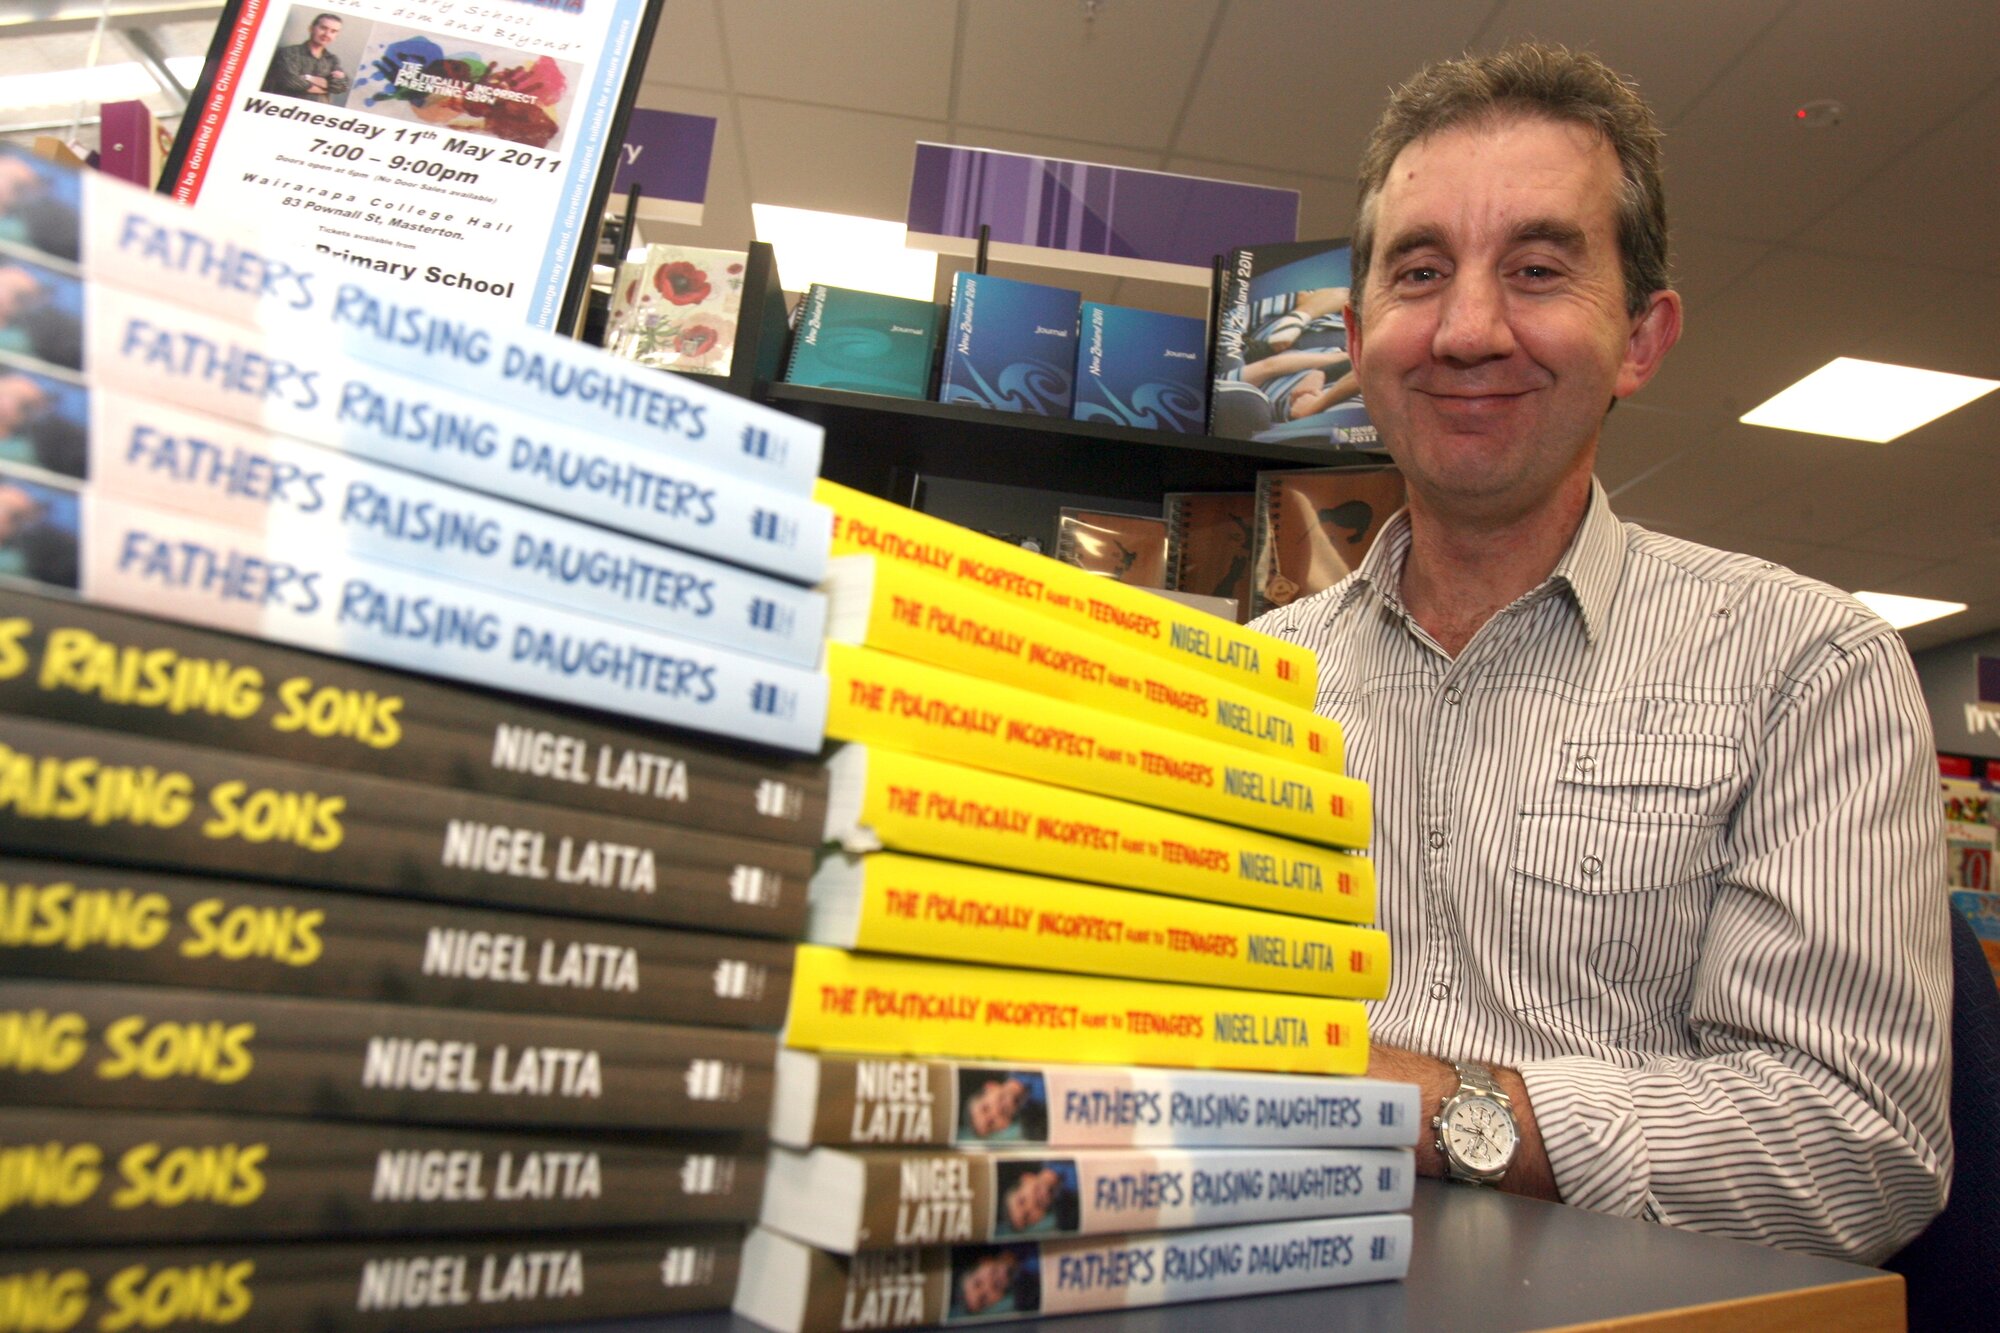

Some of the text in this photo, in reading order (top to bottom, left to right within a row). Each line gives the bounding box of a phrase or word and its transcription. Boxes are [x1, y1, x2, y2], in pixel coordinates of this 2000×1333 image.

[392, 7, 432, 23] dom
[444, 19, 484, 33] and
[464, 6, 534, 26] School
[216, 25, 250, 92] Christchurch
[401, 61, 423, 72] THE
[605, 56, 620, 87] mature
[210, 94, 226, 113] the
[394, 74, 497, 105] PARENTING SHOW
[399, 69, 538, 105] POLITICALLY INCORRECT
[597, 94, 609, 108] for
[206, 113, 218, 125] to
[242, 97, 562, 174] Wednesday 11th May 2011
[588, 108, 605, 142] suitable
[190, 126, 213, 170] donated
[308, 138, 480, 185] 7:00 9:00pm
[177, 188, 191, 208] will
[187, 171, 198, 186] be
[275, 155, 498, 205] Doors open at 6pm (No Door Sales available)
[242, 172, 514, 234] Wairarapa College Hall
[282, 197, 466, 241] 83 Pownall St, Masterton.
[565, 184, 585, 229] discretion
[318, 225, 417, 251] Tickets available from
[556, 231, 572, 263] offend,
[425, 266, 515, 299] School
[551, 263, 564, 284] may
[1236, 250, 1255, 278] 2011
[536, 284, 557, 328] language
[805, 285, 828, 346] New Zealand 2011
[958, 278, 977, 355] New Zealand 2011
[1229, 278, 1250, 331] Zealand
[890, 324, 924, 336] Journal
[1034, 325, 1068, 338] Journal
[1088, 307, 1105, 377] New Zealand 2011
[330, 282, 491, 368] RAISING
[500, 343, 710, 441] DAUGHTERS
[1163, 348, 1198, 361] Journal
[336, 379, 499, 459] RAISING
[509, 436, 717, 528] DAUGHTERS
[341, 478, 502, 557] RAISING
[511, 532, 716, 618] DAUGHTERS
[846, 518, 954, 573] POLITICALLY
[956, 557, 1046, 603] INCORRECT
[1086, 596, 1161, 641] TEENAGERS
[1169, 620, 1212, 661] NIGEL
[1215, 635, 1261, 675] LATTA
[337, 577, 501, 651] RAISING
[511, 624, 719, 706] DAUGHTERS
[890, 594, 924, 629] THE
[926, 605, 1026, 657] POLITICALLY
[1028, 642, 1107, 685] INCORRECT
[1143, 678, 1209, 719] TEENAGERS
[1216, 698, 1254, 737] NIGEL
[1256, 714, 1295, 748] LATTA
[38, 627, 264, 719] RAISING
[272, 676, 404, 749] SONS
[491, 722, 591, 784] NIGEL
[595, 743, 690, 804] LATTA
[849, 678, 884, 712] THE
[889, 687, 1002, 738] POLITICALLY
[1005, 716, 1096, 761] INCORRECT
[1138, 748, 1215, 789] TEENAGERS
[1222, 766, 1267, 804] NIGEL
[1270, 777, 1316, 815] LATTA
[0, 743, 658, 894] AISING SONS NIGEL LATTA
[887, 783, 922, 818] THE
[924, 791, 1032, 836] POLITICALLY
[1034, 815, 1120, 855] INCORRECT
[1160, 840, 1231, 875] TEENAGERS
[1238, 850, 1280, 888] NIGEL
[1282, 856, 1324, 893] LATTA
[178, 898, 641, 993] SONS NIGEL LATTA
[885, 888, 921, 920] THE
[923, 892, 1033, 932] POLITICALLY
[1036, 911, 1125, 944] INCORRECT
[1166, 928, 1239, 960] TEENAGERS
[1246, 934, 1291, 969] NIGEL
[1292, 938, 1336, 974] LATTA
[820, 984, 857, 1016] THE
[862, 986, 980, 1024] POLITICALLY
[984, 1000, 1079, 1031] INCORRECT
[1126, 1010, 1205, 1039] TEENAGERS
[1212, 1011, 1259, 1045] NIGEL
[1262, 1014, 1310, 1048] LATTA
[96, 1014, 257, 1085] SONS
[361, 1035, 481, 1094] NIGEL
[488, 1044, 604, 1099] LATTA
[856, 1060, 934, 1104] NIGEL
[850, 1103, 934, 1142] LATTA
[1169, 1090, 1250, 1129] RAISING
[1254, 1094, 1363, 1131] DAUGHTERS
[109, 1140, 603, 1210] SONS NIGEL LATTA
[899, 1158, 975, 1201] NIGEL
[1191, 1162, 1263, 1207] RAISING
[1267, 1164, 1364, 1202] DAUGHTERS
[894, 1201, 974, 1245] LATTA
[850, 1248, 926, 1288] NIGEL
[1162, 1237, 1243, 1282] RAISING
[1247, 1234, 1355, 1277] DAUGHTERS
[97, 1247, 585, 1333] SONS NIGEL LATTA
[841, 1286, 926, 1331] LATTA
